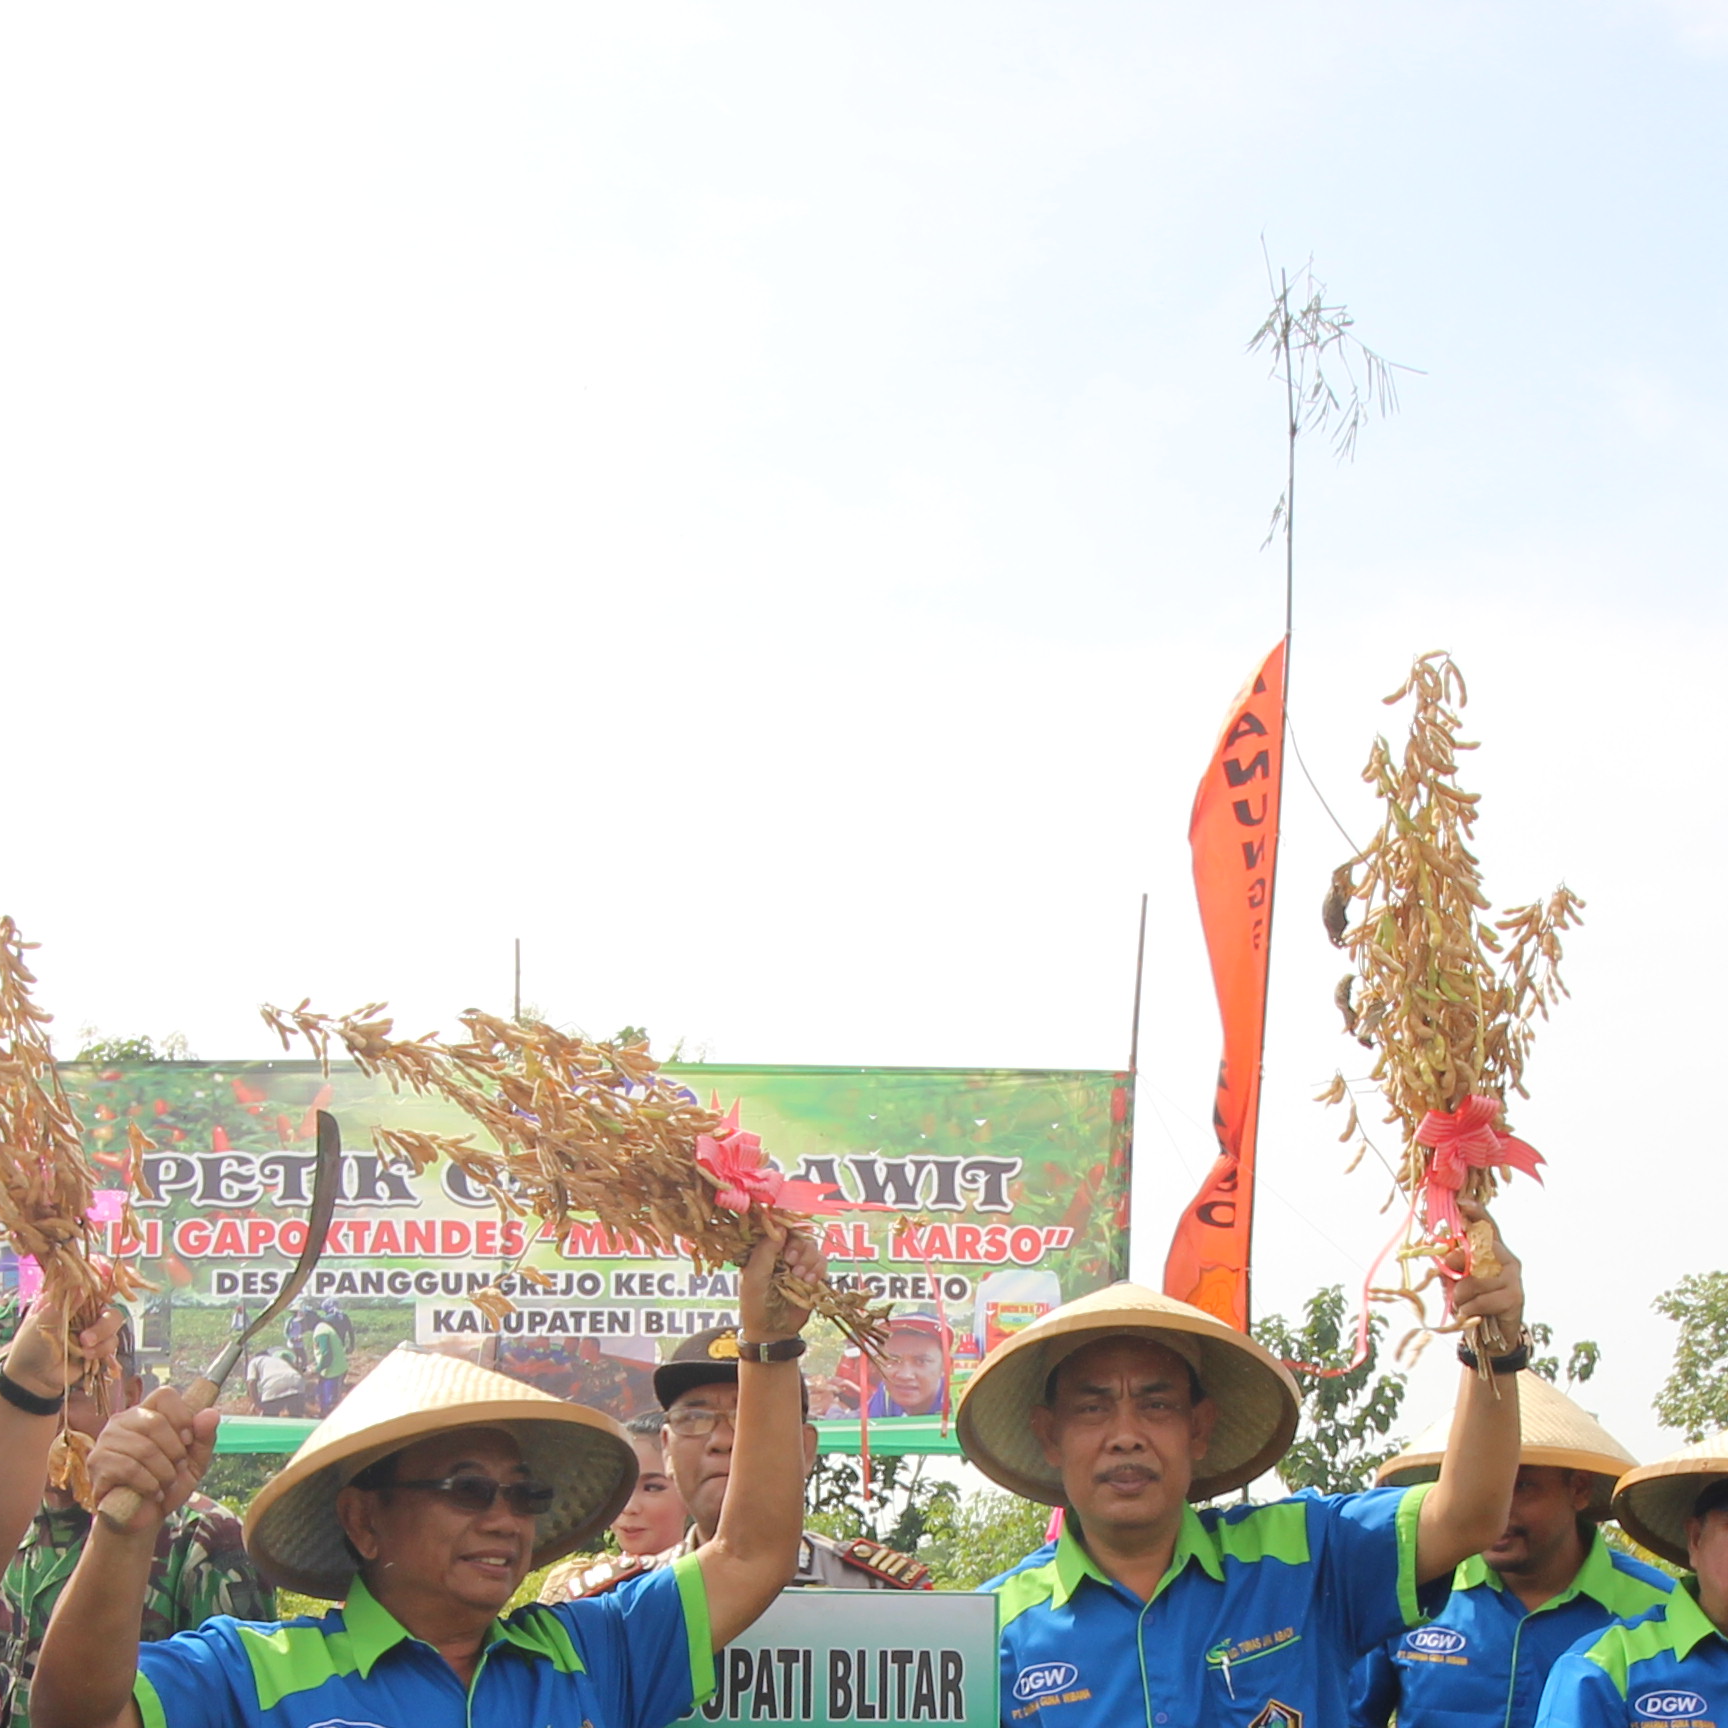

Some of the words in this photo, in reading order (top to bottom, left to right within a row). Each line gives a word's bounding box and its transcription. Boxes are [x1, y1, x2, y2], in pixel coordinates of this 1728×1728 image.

[135, 1152, 420, 1207] PETIK
[177, 1219, 525, 1257] GAPOKTANDES
[320, 1271, 603, 1298] PANGGUNGREJO
[1415, 1632, 1458, 1649] DGW
[679, 1648, 813, 1721] UPATI
[828, 1649, 965, 1721] BLITAR
[1020, 1666, 1067, 1696] DGW
[1646, 1696, 1699, 1713] DGW
